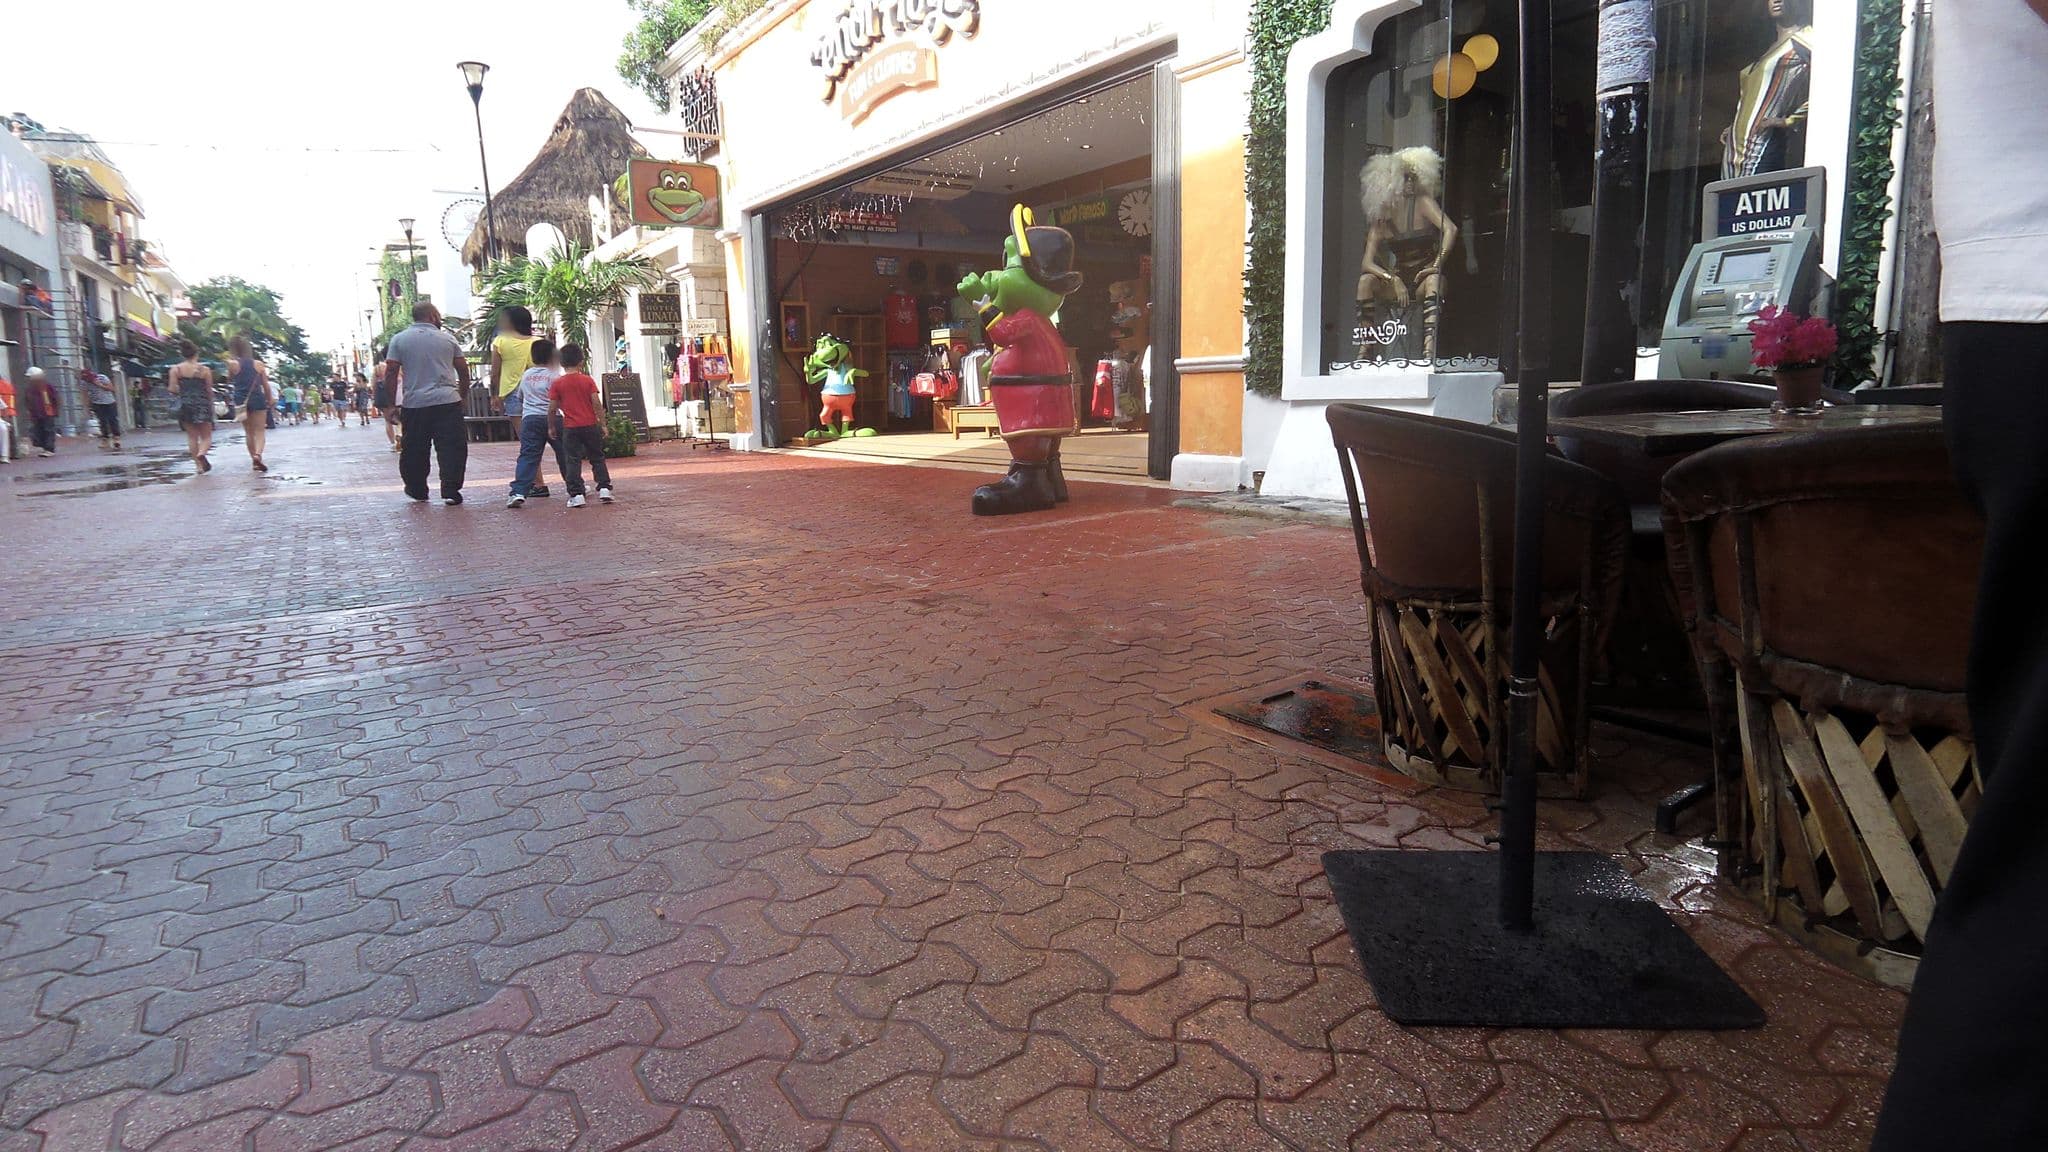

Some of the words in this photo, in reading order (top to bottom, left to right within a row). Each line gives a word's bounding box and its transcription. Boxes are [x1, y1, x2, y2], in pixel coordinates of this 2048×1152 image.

[1735, 186, 1789, 216] ATM
[1732, 221, 1746, 233] US
[1749, 216, 1791, 231] DOLLAR
[642, 311, 680, 322] LUNATA
